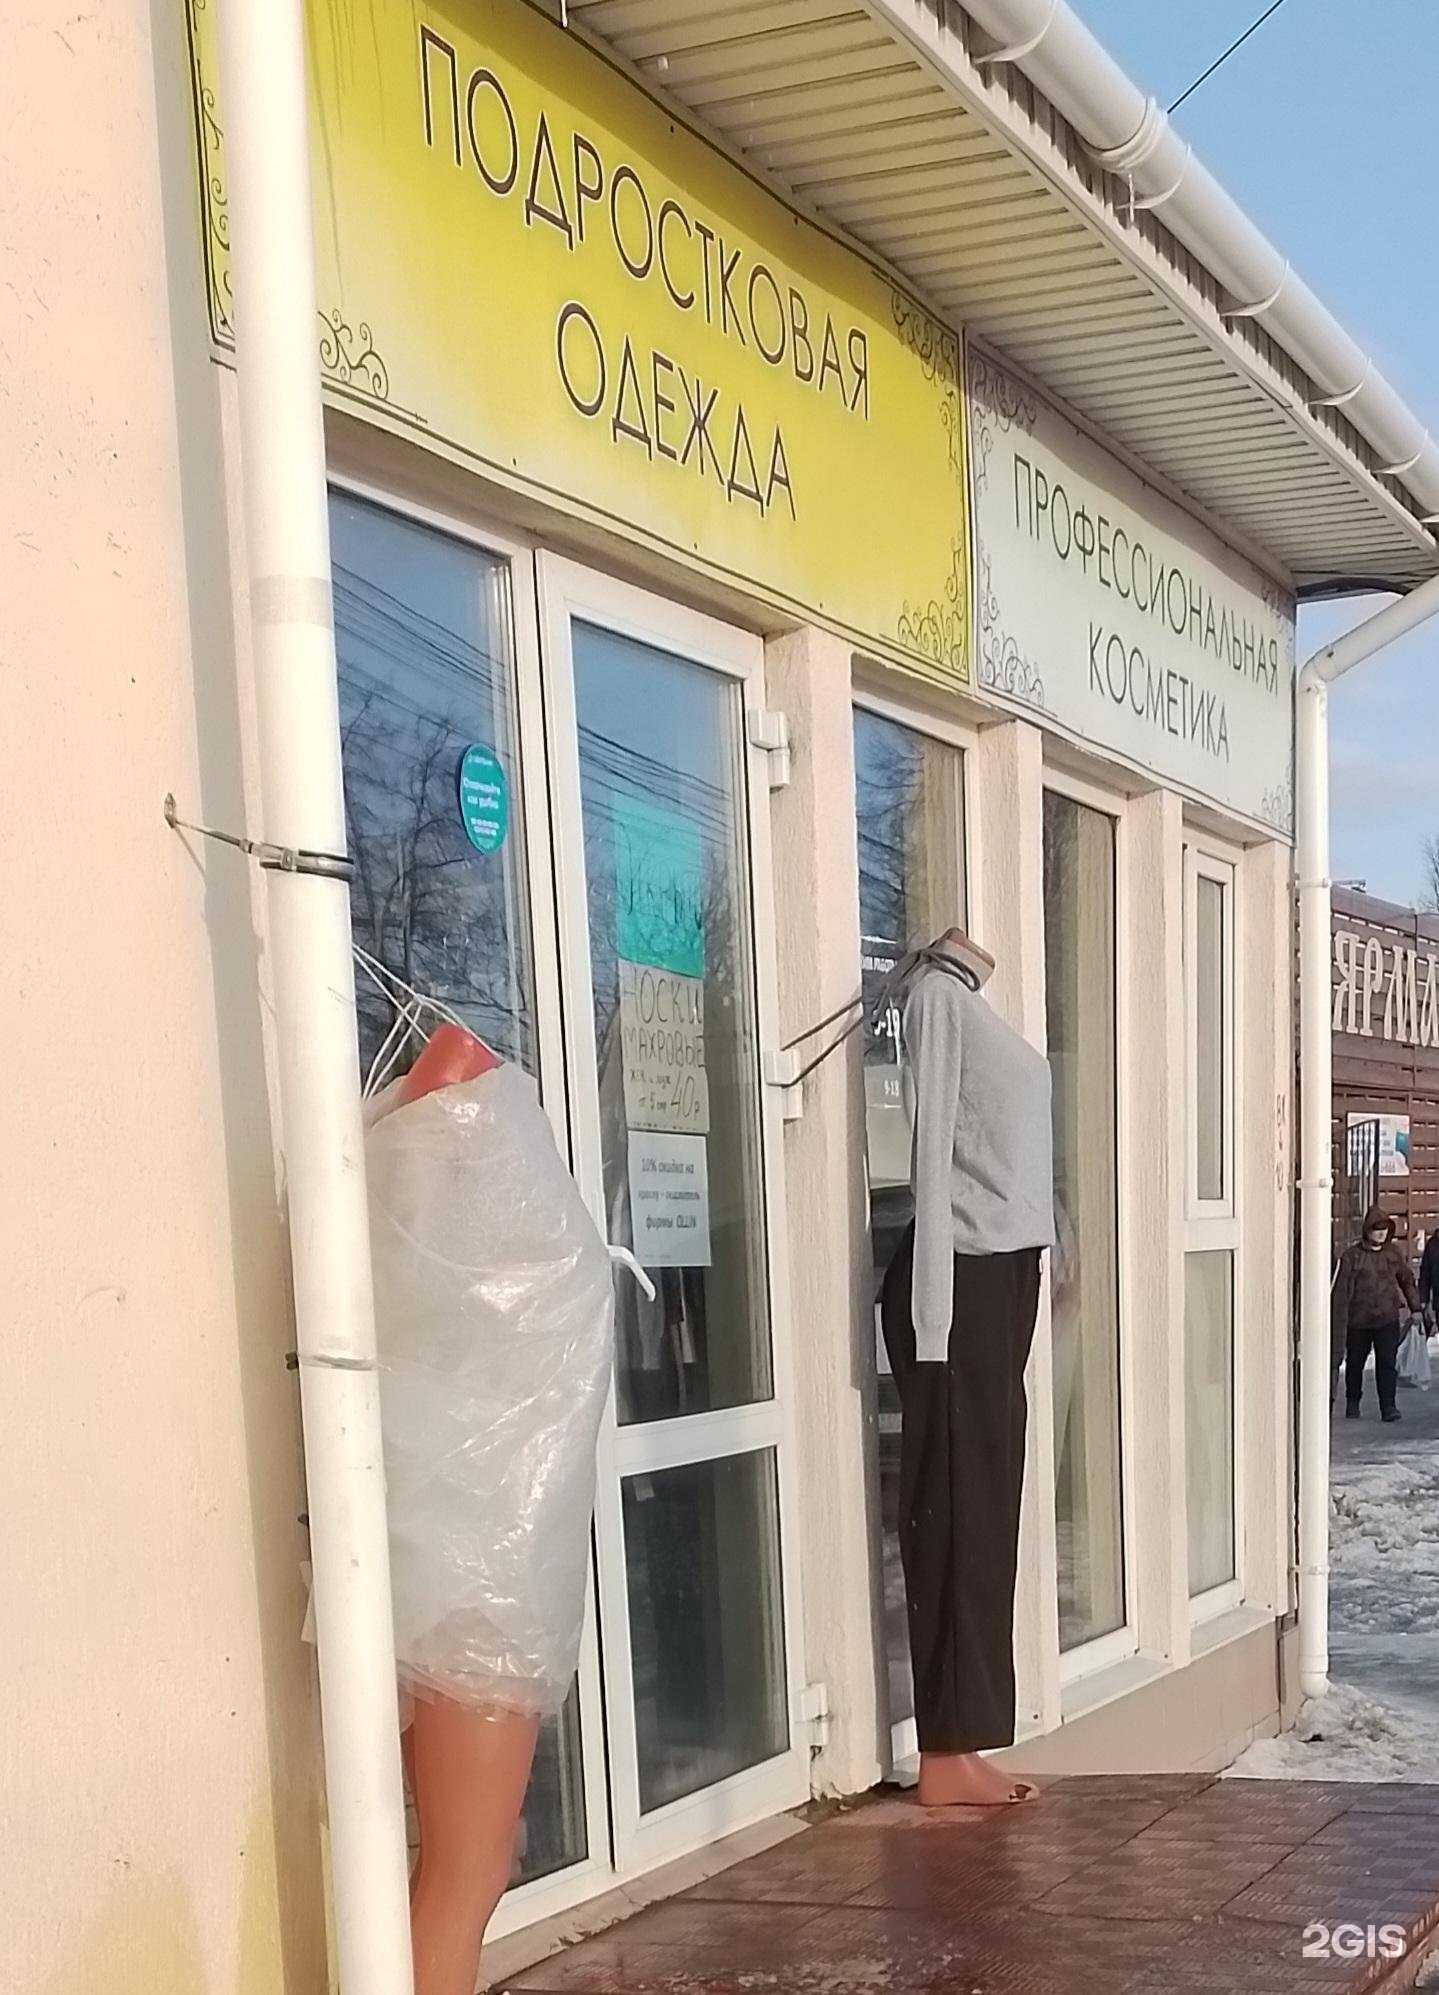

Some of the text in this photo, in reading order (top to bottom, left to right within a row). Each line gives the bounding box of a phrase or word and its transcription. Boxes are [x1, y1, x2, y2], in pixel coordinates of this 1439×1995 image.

[420, 24, 869, 421] ПОДРОСТКОВАЯ
[556, 301, 797, 522] ОДЕЖДА
[1013, 452, 1279, 697] ПРОФЕССИОНАЛЬНАЯ
[1088, 621, 1230, 763] КОСМЕТИКА
[623, 967, 703, 1025] НОСКИ
[623, 1027, 705, 1069] МАХРОВЫЕ
